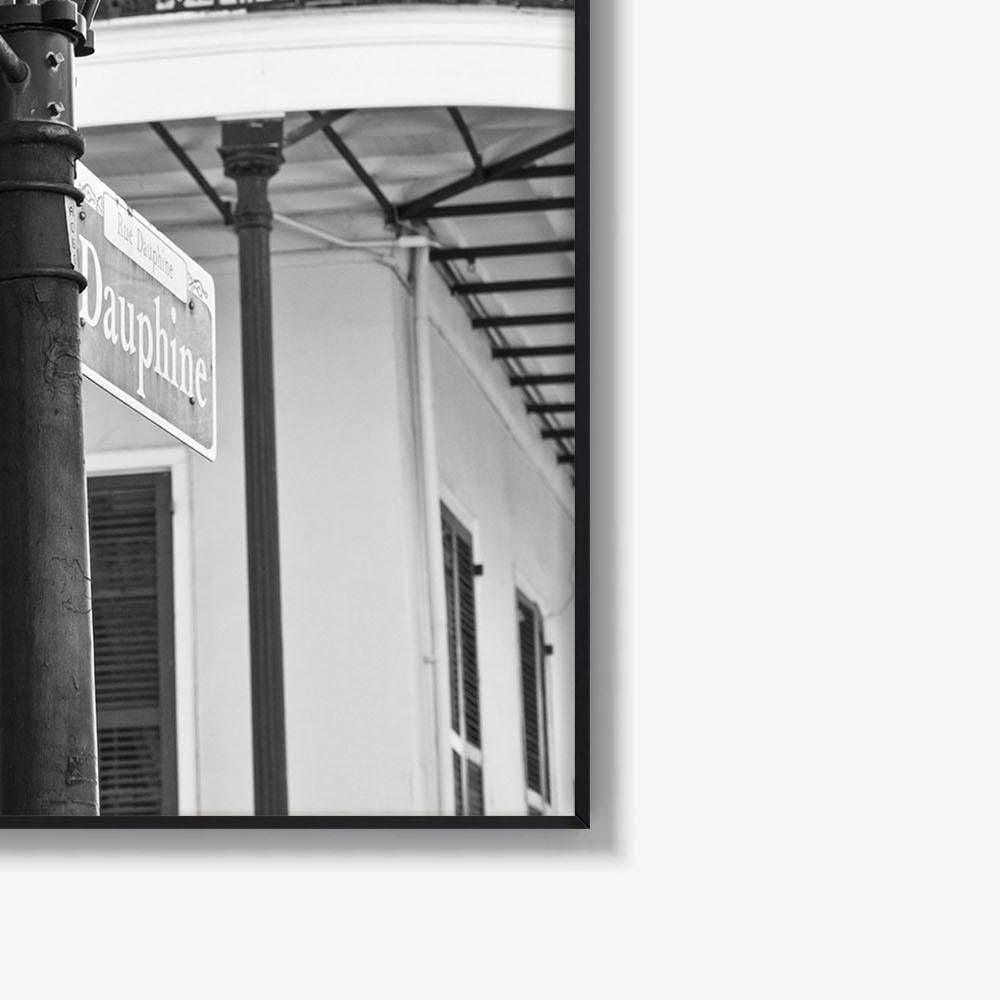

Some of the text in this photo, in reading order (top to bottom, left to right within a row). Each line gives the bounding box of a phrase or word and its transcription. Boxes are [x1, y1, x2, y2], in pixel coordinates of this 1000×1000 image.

[117, 211, 133, 246] Rue
[136, 227, 174, 279] Dauphine
[79, 234, 209, 409] Dauphine
